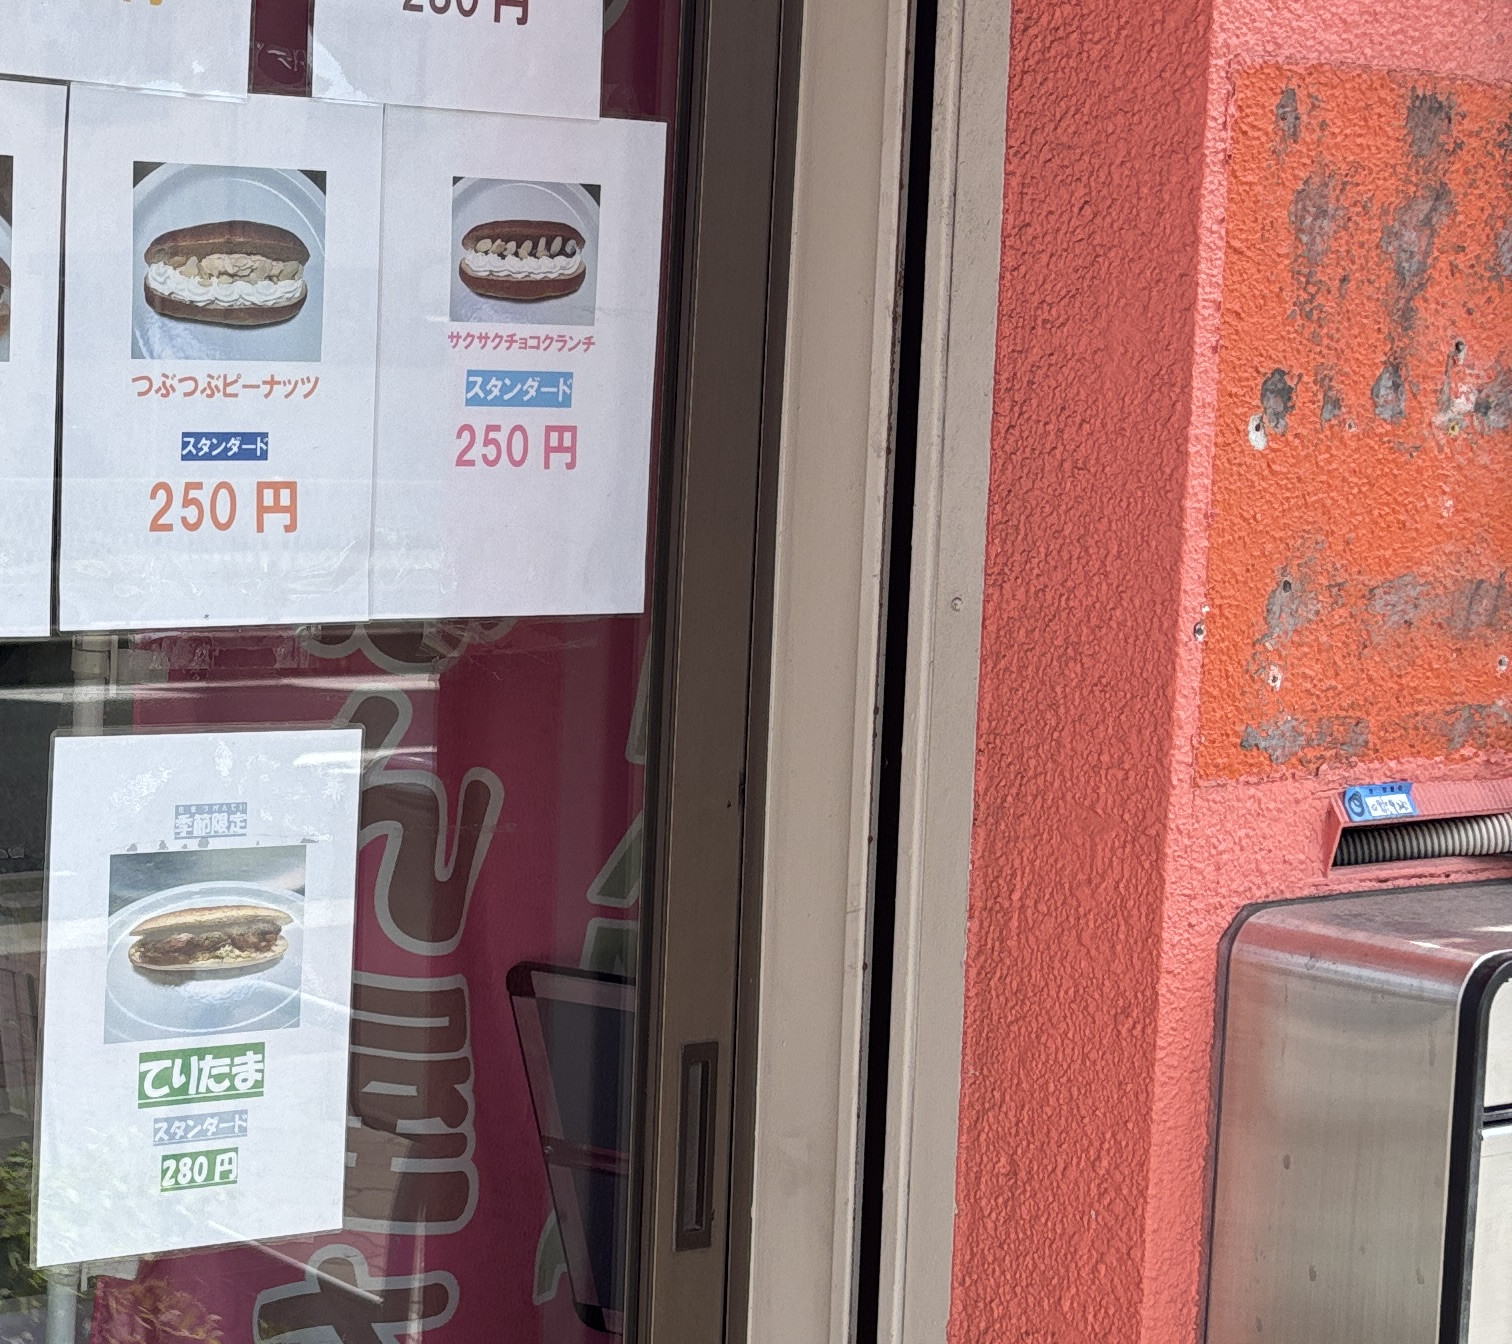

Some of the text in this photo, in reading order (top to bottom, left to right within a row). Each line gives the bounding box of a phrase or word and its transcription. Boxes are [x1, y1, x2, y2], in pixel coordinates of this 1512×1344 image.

[448, 331, 596, 353] サクサクチョコクランチ
[131, 373, 320, 399] つぶつぶピーナッツ
[466, 374, 572, 402] スタンダード
[182, 436, 268, 457] スタンダード
[175, 812, 246, 836] 季節限定
[140, 1052, 265, 1099] てりたま
[154, 1113, 248, 1142] スタンダード
